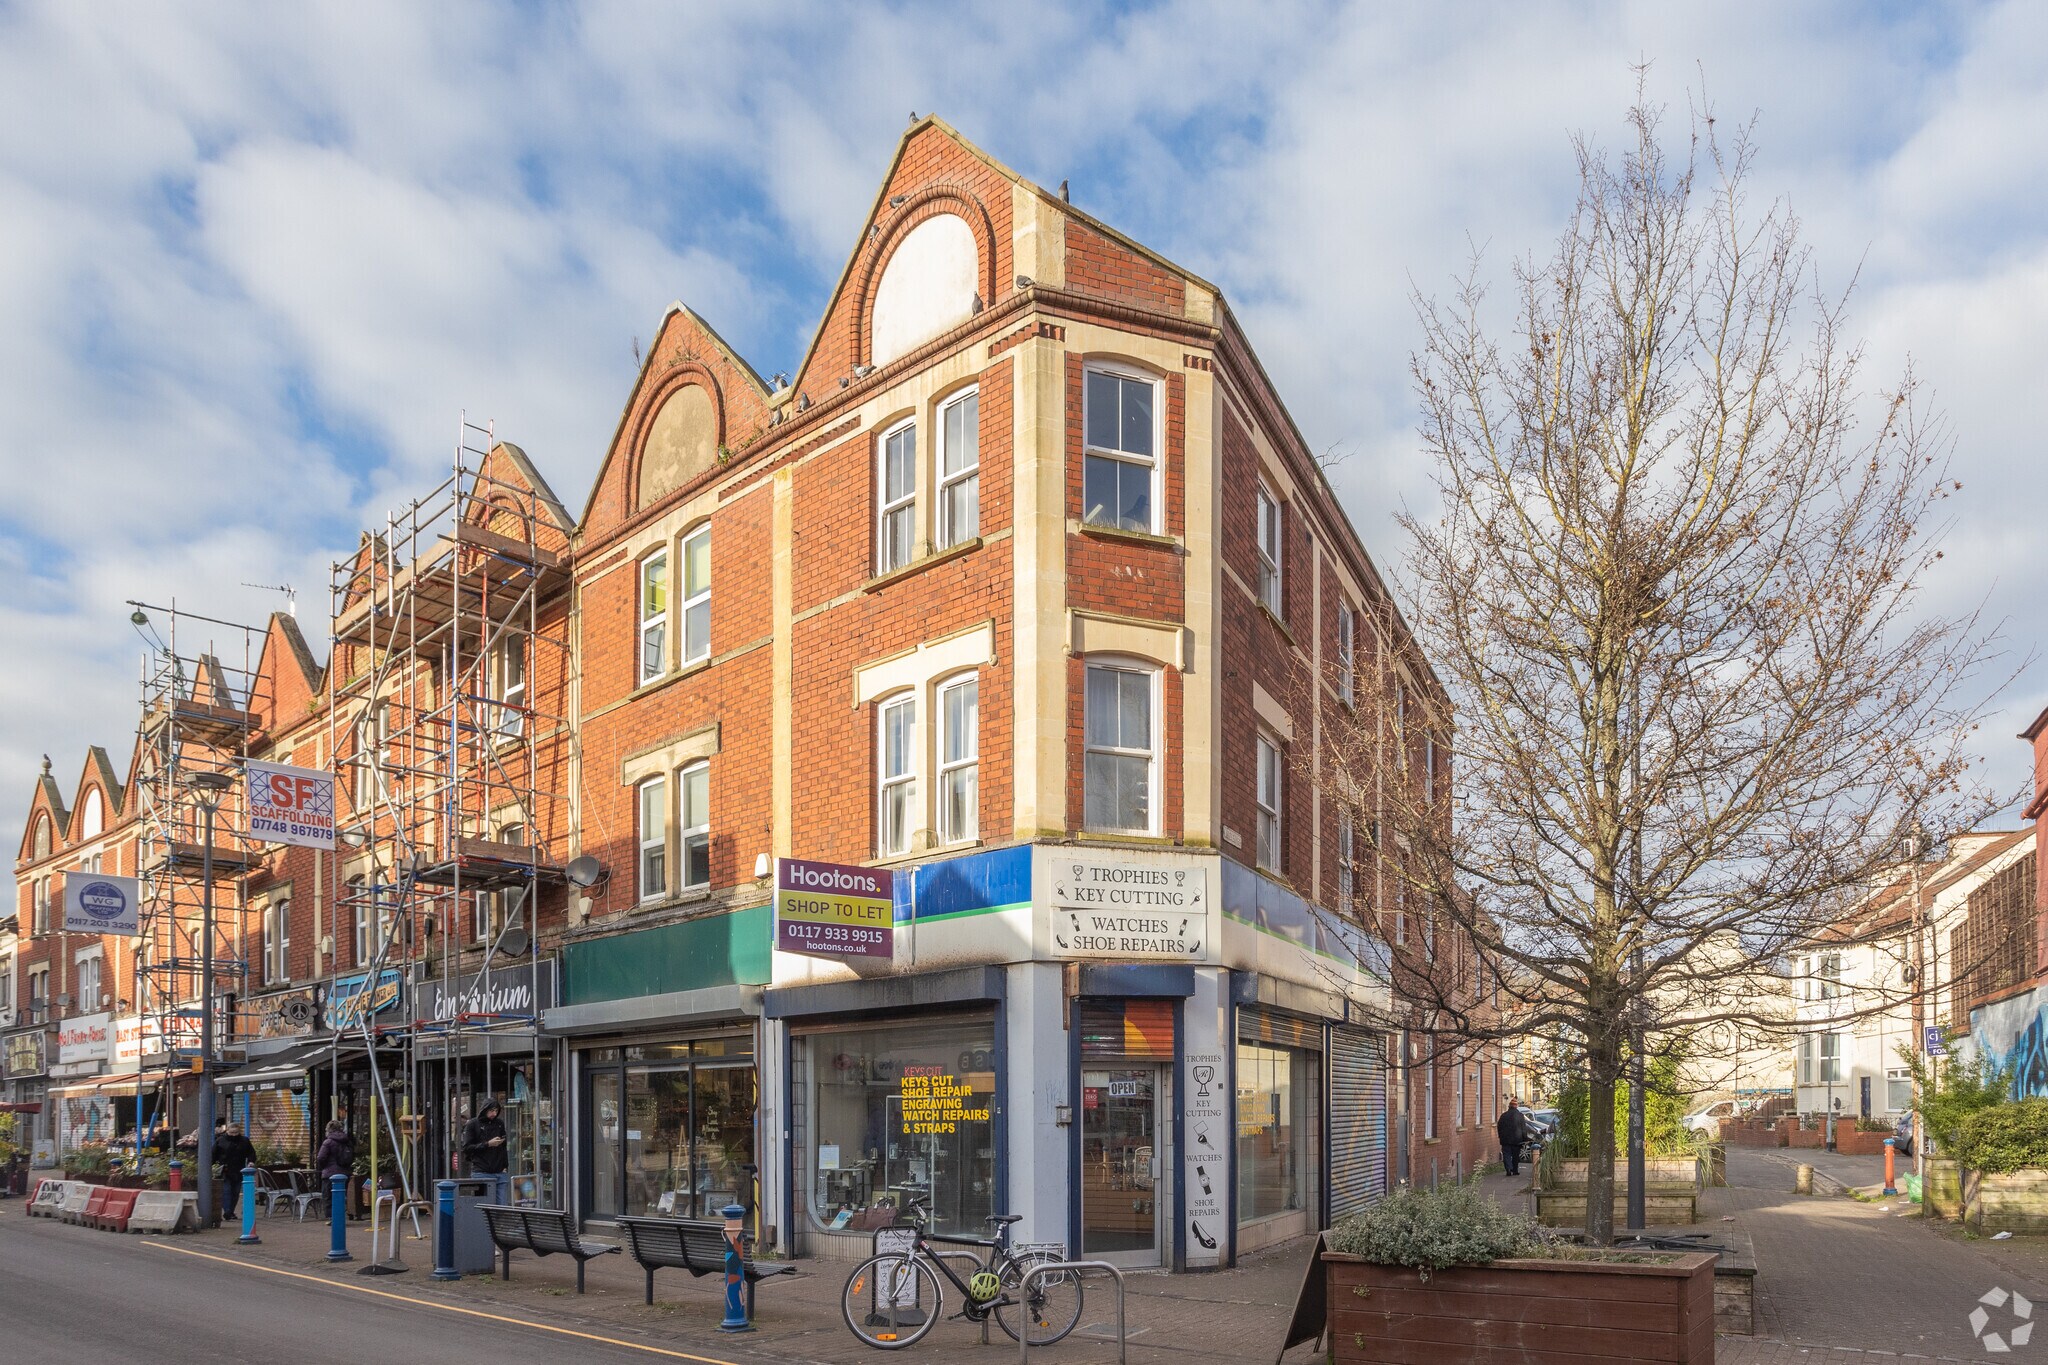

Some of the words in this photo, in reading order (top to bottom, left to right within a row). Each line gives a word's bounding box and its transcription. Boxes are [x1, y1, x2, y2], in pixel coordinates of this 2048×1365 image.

[270, 774, 314, 811] SF
[251, 805, 333, 828] SCAFFOLDING
[252, 818, 287, 833] 07748
[290, 824, 333, 840] 967879
[790, 864, 881, 893] Hootons.
[1090, 867, 1169, 885] TROPHIES
[92, 896, 114, 905] WG
[1075, 887, 1106, 903] KEY
[1110, 889, 1184, 906] CUTTING
[787, 899, 830, 914] SHOP
[834, 903, 853, 917] TO
[857, 905, 884, 919] LET
[67, 917, 88, 926] 0117
[90, 919, 109, 928] 203
[112, 921, 137, 930] 3290
[1091, 916, 1169, 933] WATCHES
[788, 925, 821, 939] 0117
[825, 927, 849, 941] 933
[852, 929, 883, 943] 9915
[806, 940, 867, 953] hootons.co.uk
[1073, 936, 1117, 950] SHOE
[1120, 938, 1185, 953] REPAIRS
[1186, 1055, 1222, 1063] TROPHIES
[904, 1066, 925, 1077] KEYS
[925, 1066, 943, 1077] CUT
[901, 1077, 929, 1088] KEYS
[931, 1075, 954, 1087] CUT
[901, 1087, 930, 1099] SHOE
[933, 1085, 973, 1097] REPAIR
[1111, 1082, 1135, 1095] OPEN
[902, 1098, 963, 1110] ENGRAVING
[903, 1109, 939, 1121] WATCH
[942, 1109, 990, 1121] REPAIRS
[1186, 1109, 1222, 1117] CUTTING
[902, 1123, 911, 1134] &
[913, 1122, 956, 1134] STRAPS
[1186, 1154, 1223, 1162] WATCHES
[1194, 1199, 1215, 1207] SHOE
[1189, 1208, 1220, 1217] REPAIRS
